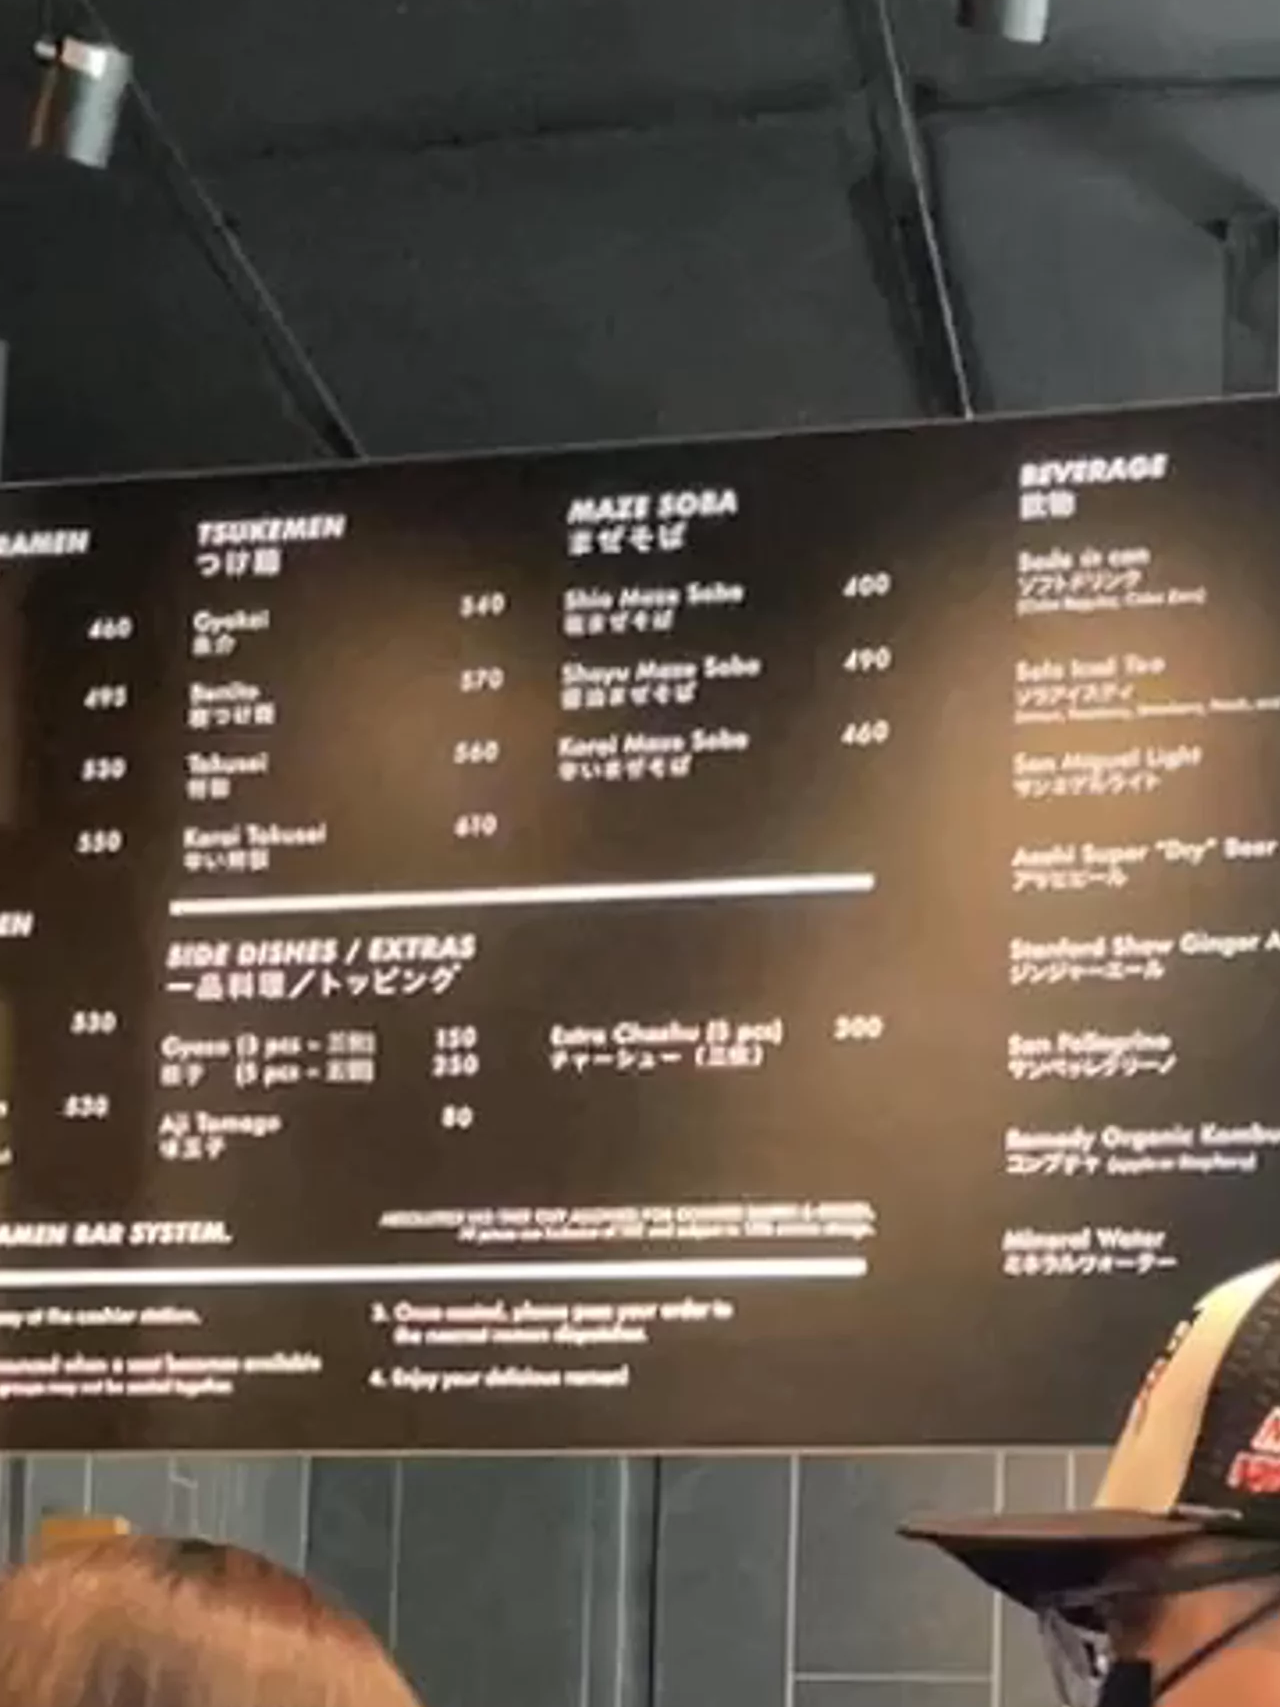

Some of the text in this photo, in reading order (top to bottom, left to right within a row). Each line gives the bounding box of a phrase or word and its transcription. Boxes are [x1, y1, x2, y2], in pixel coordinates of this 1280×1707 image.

[1020, 453, 1168, 487] BEVERAGE
[567, 488, 738, 525] MAZE SOBA
[197, 513, 347, 546] TSUKEMEN
[166, 942, 230, 969] SIDE
[237, 937, 338, 966] DISHES
[368, 933, 477, 962] EXTRAS
[1179, 931, 1261, 958] Ginger
[74, 1221, 122, 1245] BAR
[128, 1220, 232, 1244] SYSTEM.
